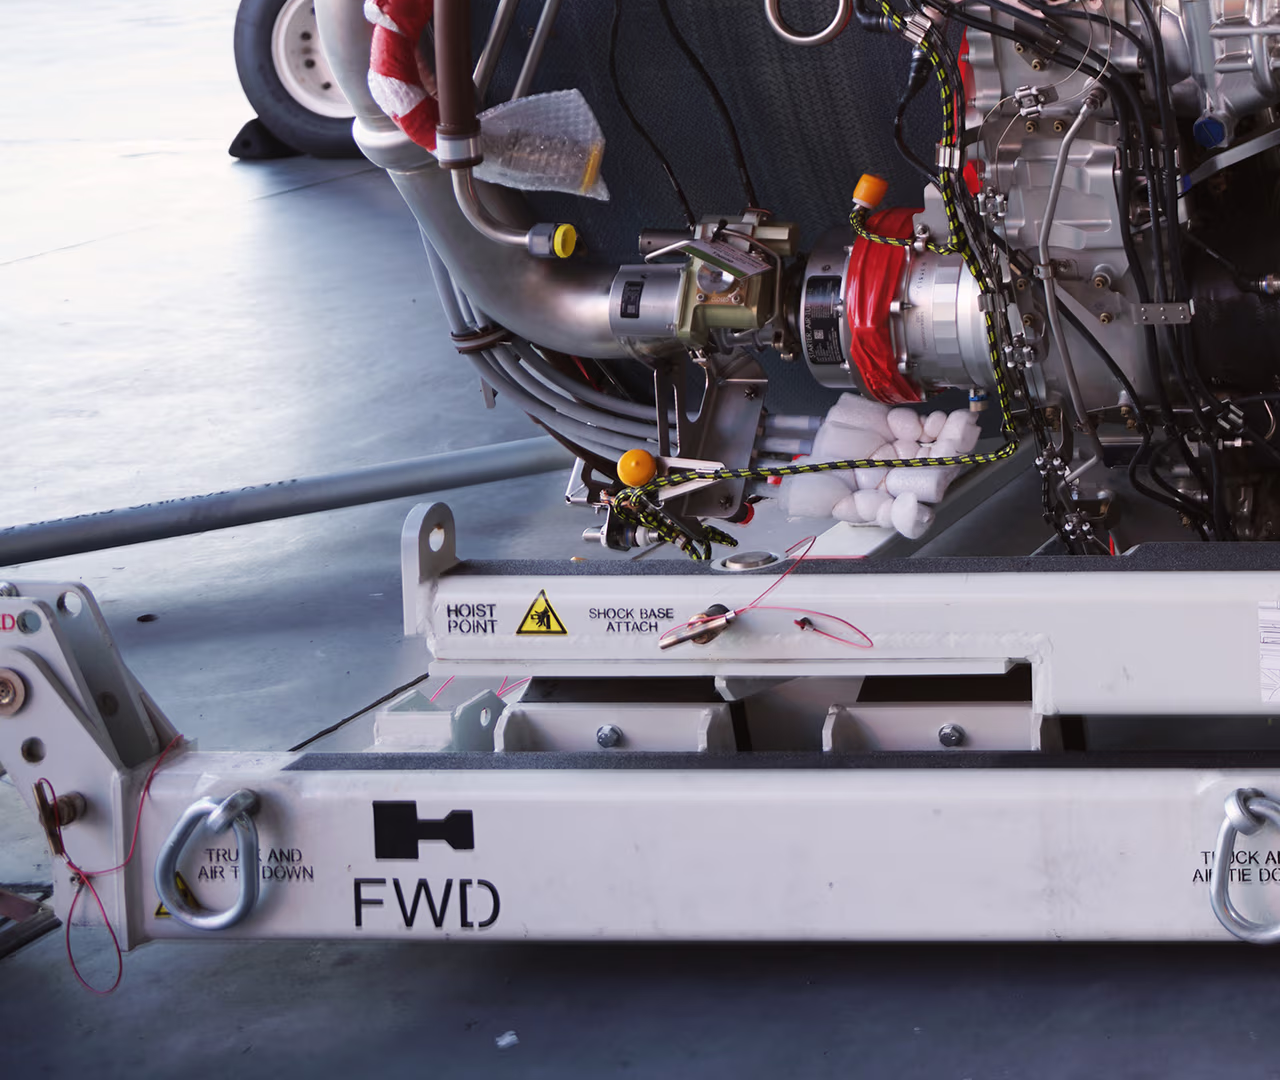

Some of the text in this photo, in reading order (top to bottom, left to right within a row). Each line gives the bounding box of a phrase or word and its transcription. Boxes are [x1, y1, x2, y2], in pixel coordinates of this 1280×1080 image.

[447, 604, 496, 618] HOIST
[589, 608, 673, 619] SHOCK BASE
[448, 620, 497, 633] POINT
[607, 621, 658, 632] ATTACH
[206, 847, 303, 863] TRUK AND
[1201, 851, 1259, 864] TUCK
[198, 866, 224, 882] AIR
[261, 865, 314, 880] DOWN
[1228, 869, 1251, 882] TIE
[353, 878, 500, 928] FWD
